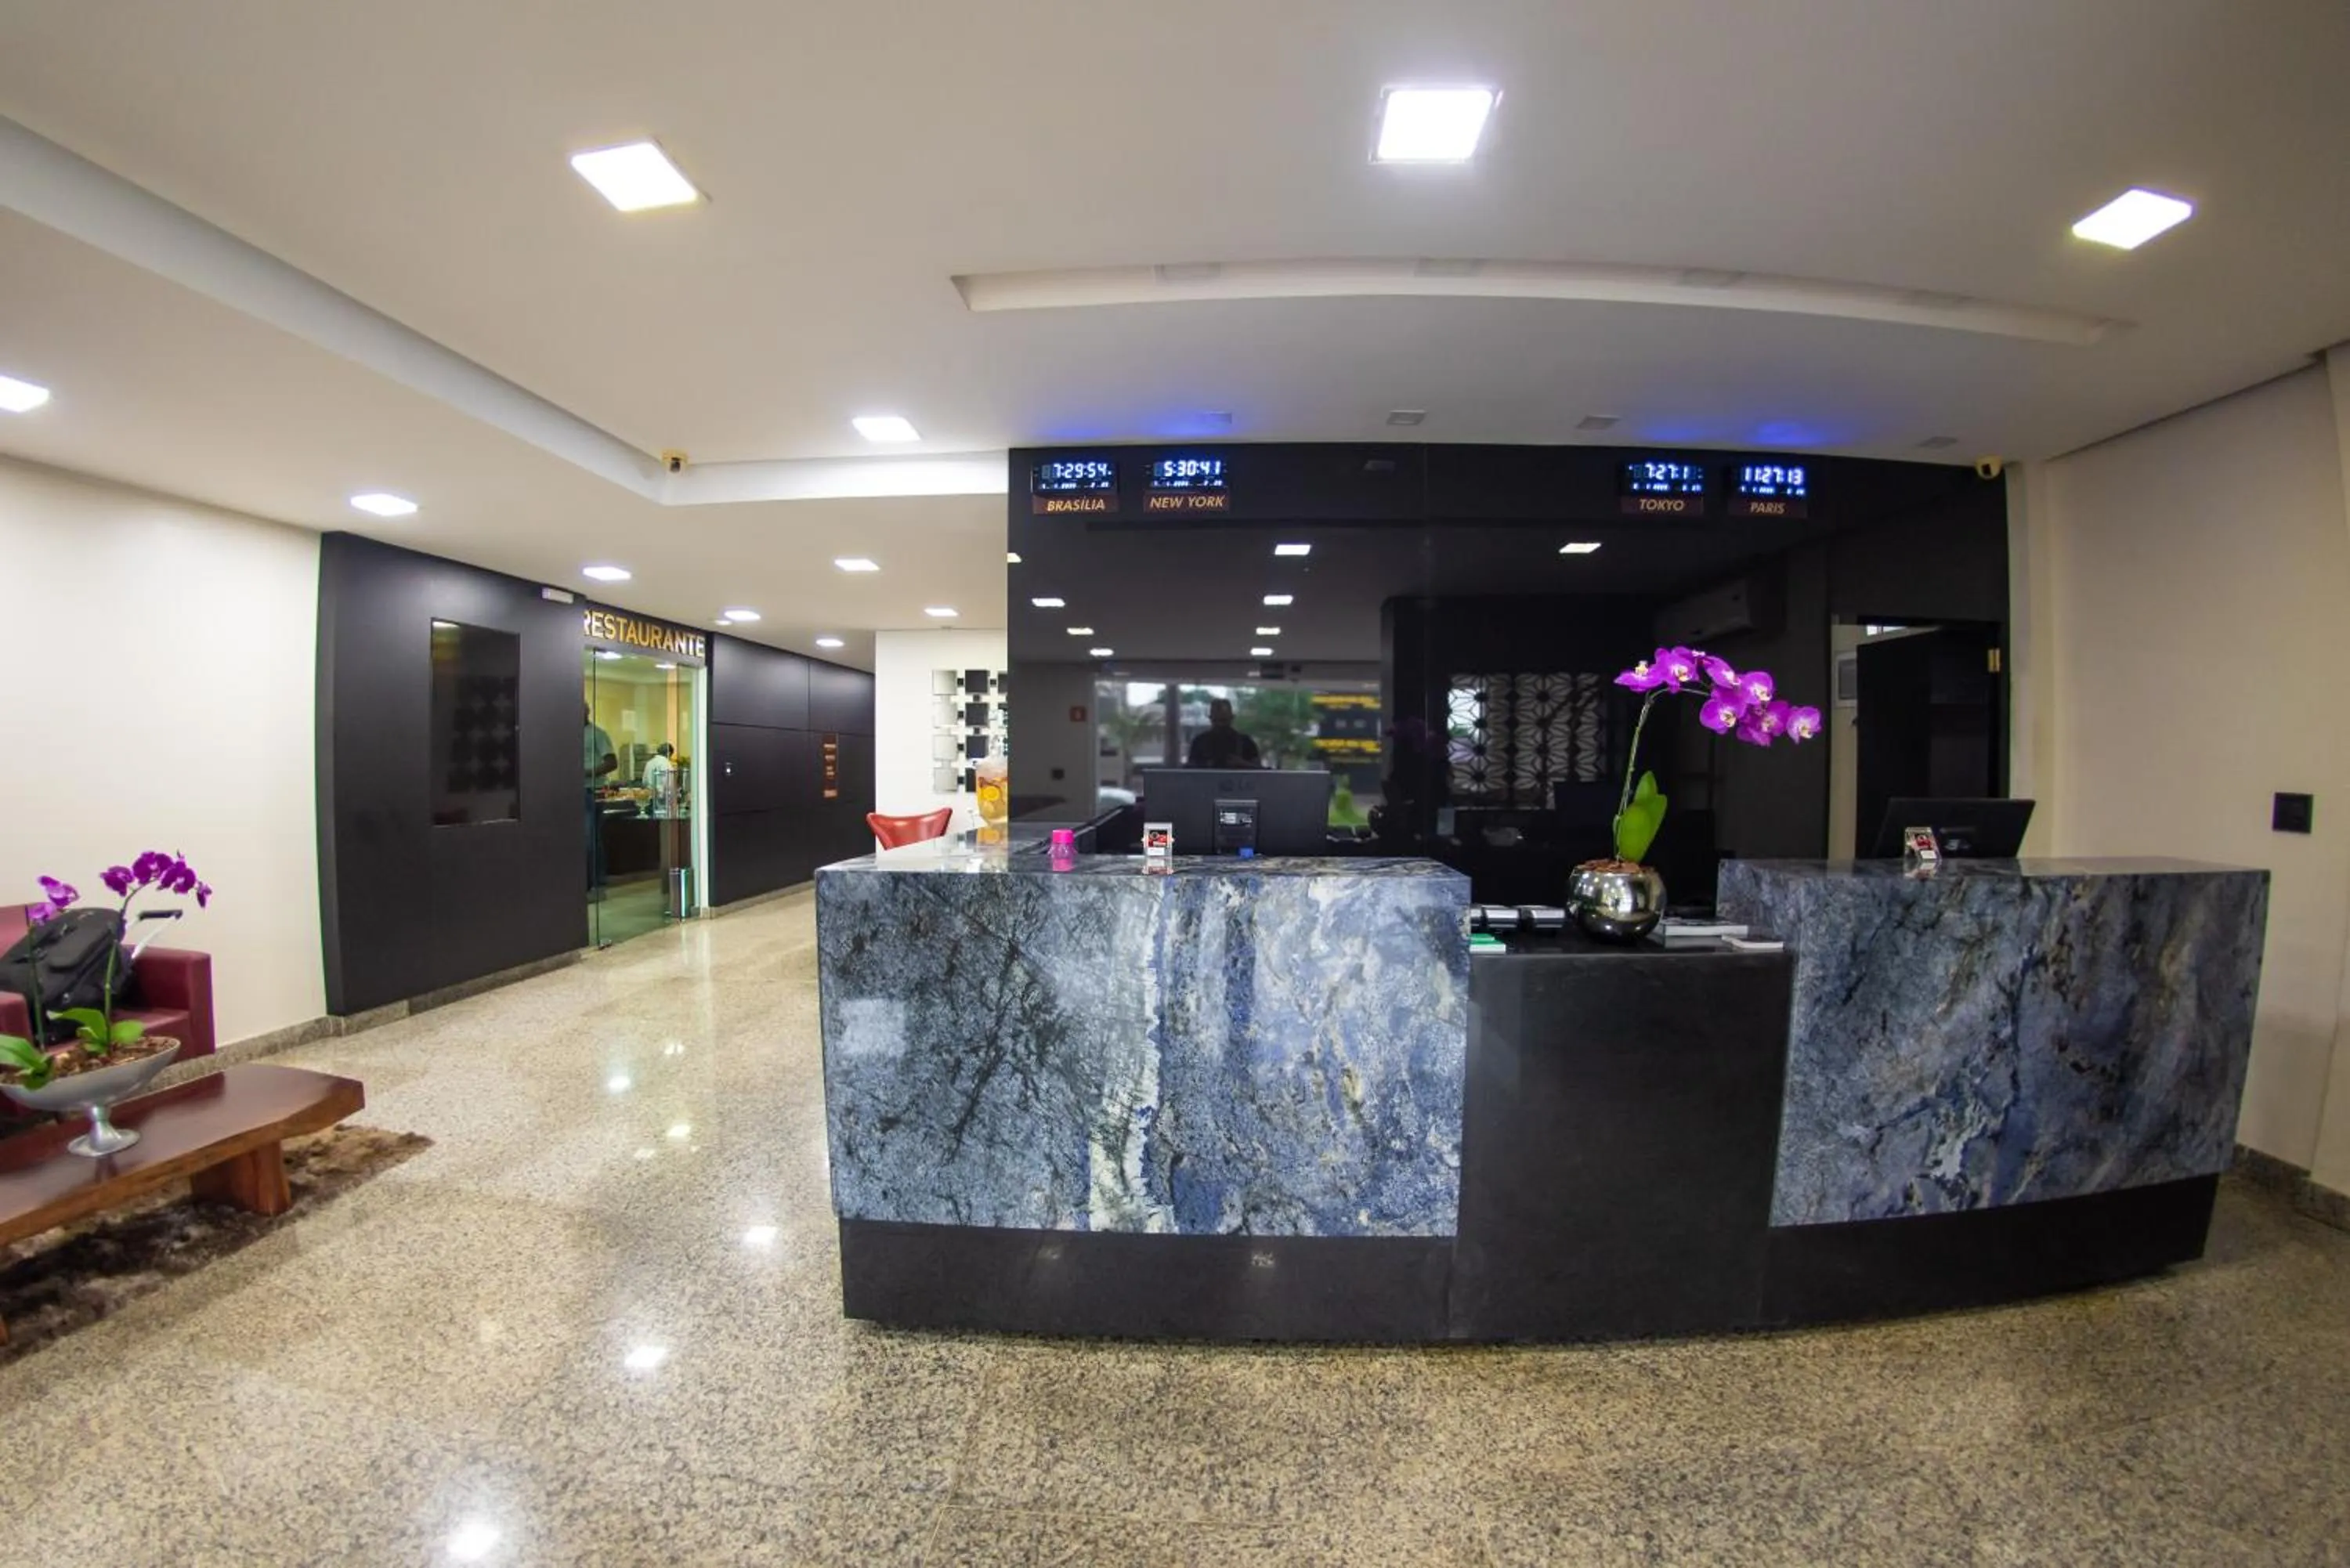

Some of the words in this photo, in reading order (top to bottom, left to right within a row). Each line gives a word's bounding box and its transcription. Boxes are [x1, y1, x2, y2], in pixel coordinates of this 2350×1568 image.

[1047, 495, 1106, 511] BRASÍLIA
[1149, 497, 1184, 509] NEW
[1188, 494, 1226, 508] YORK
[1640, 498, 1685, 511] TOKYO
[1749, 501, 1786, 514] PARIS
